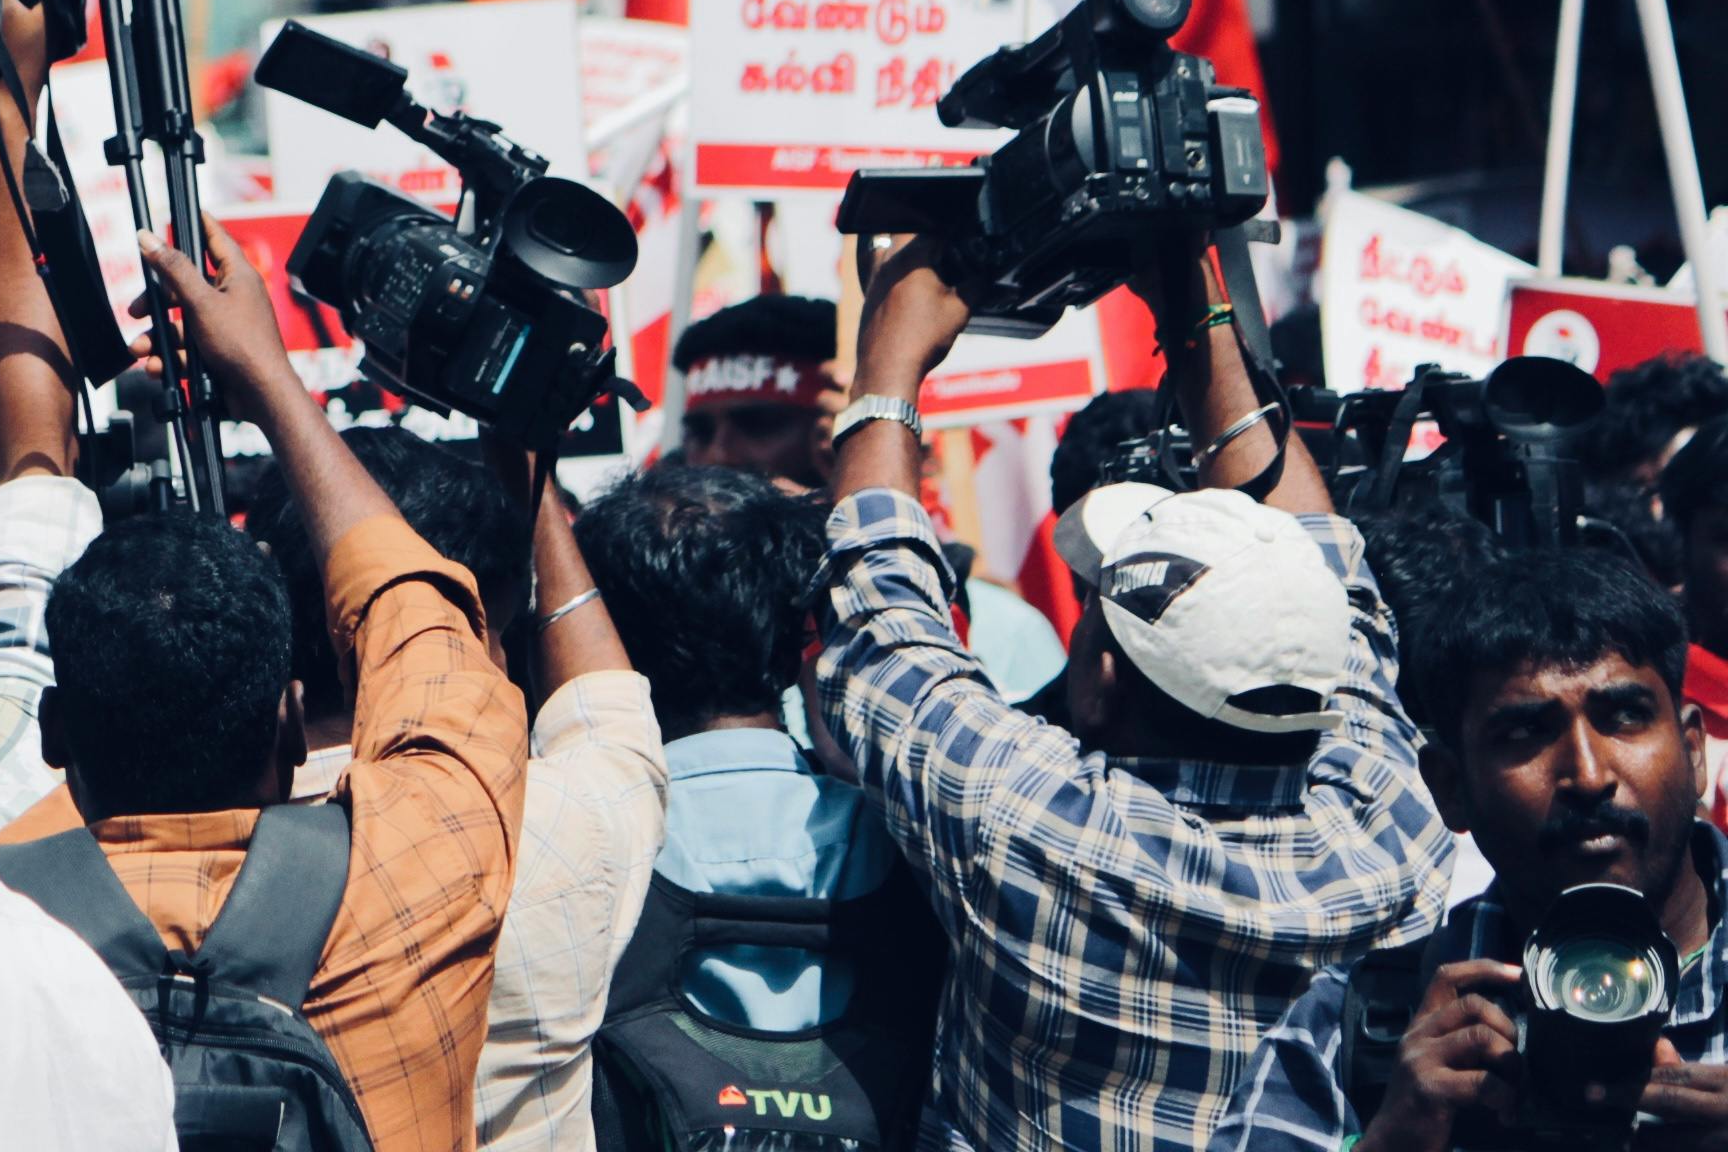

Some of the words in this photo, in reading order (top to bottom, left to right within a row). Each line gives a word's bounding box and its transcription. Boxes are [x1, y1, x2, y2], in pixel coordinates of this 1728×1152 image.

[739, 48, 857, 94] கல்வி
[702, 354, 775, 394] AISF
[746, 1088, 833, 1121] TVU
